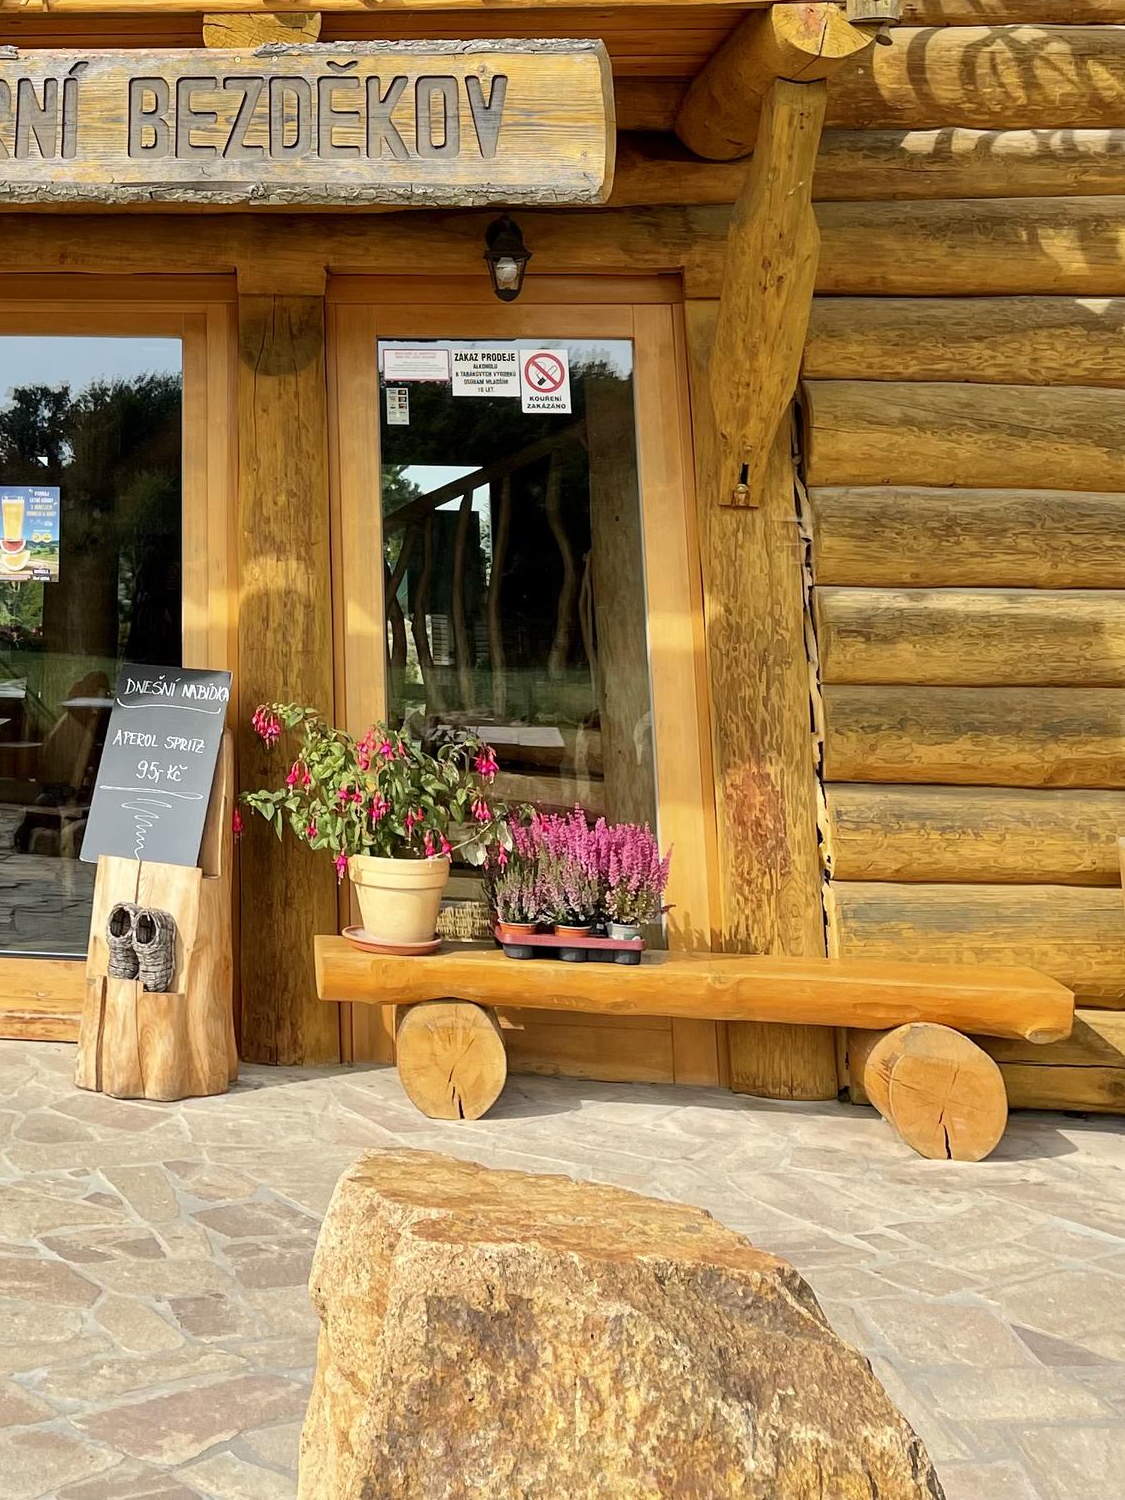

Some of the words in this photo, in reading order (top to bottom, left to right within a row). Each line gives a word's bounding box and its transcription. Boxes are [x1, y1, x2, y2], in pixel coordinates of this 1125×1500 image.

[128, 60, 508, 159] BEZDĚKOV
[481, 352, 516, 362] PRODEJE
[526, 402, 567, 410] ZAKÁZÁNO
[124, 675, 181, 697] DNEŠNÍ
[181, 683, 229, 702] NABÍDKA
[112, 729, 158, 748] APEROL
[164, 736, 206, 754] SPRITZ
